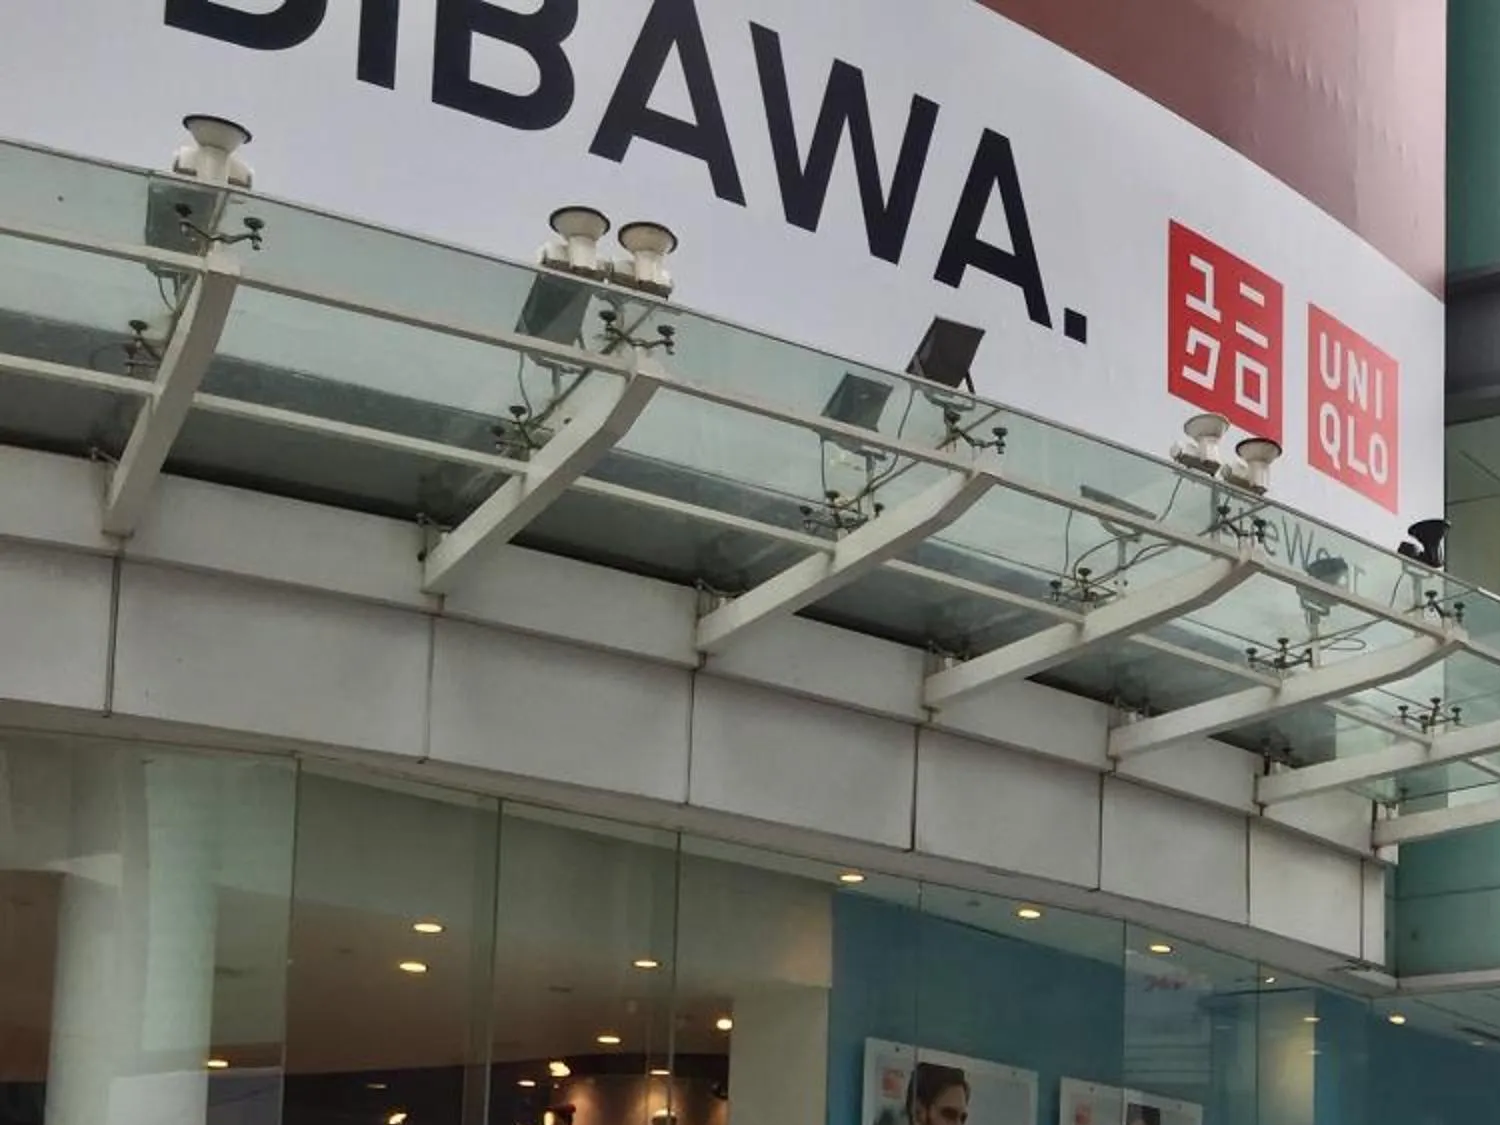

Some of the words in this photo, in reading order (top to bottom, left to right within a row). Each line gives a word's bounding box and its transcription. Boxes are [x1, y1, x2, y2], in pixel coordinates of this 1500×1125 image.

[164, 0, 1088, 345] BAWA.
[1319, 331, 1384, 420] UNI
[1319, 402, 1389, 486] QLO
